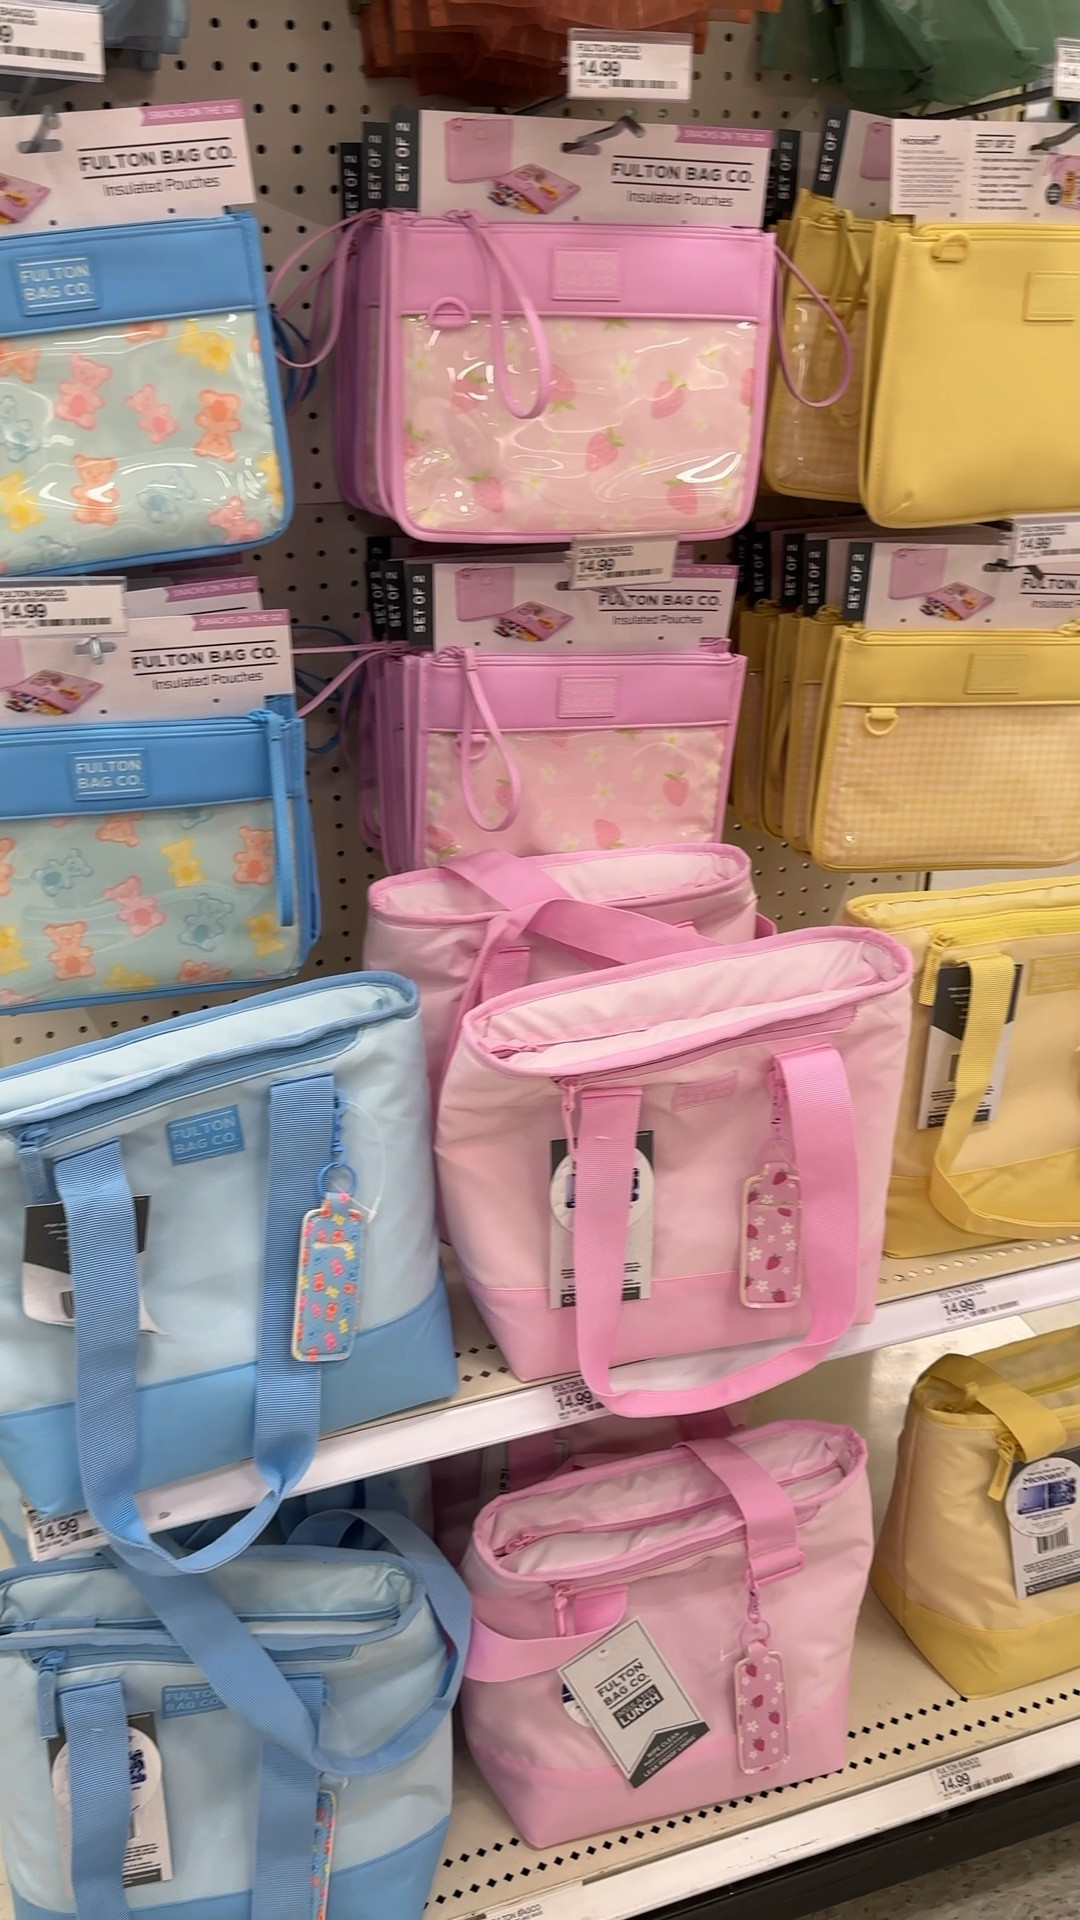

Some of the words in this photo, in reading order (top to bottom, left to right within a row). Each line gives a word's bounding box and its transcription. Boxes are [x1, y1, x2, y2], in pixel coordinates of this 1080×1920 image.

[578, 59, 621, 77] 14.99
[395, 122, 411, 132] 2
[395, 137, 411, 158] OF
[824, 132, 838, 151] OF
[78, 151, 157, 172] FULTON
[160, 149, 201, 165] BAG
[204, 146, 238, 161] CO.
[367, 148, 382, 168] OF
[778, 154, 792, 172] OF
[344, 168, 358, 187] OF
[395, 163, 410, 192] SET
[611, 162, 681, 180] FULTON
[684, 166, 722, 182] BAG
[725, 169, 755, 184] CO.
[818, 155, 835, 182] SET
[103, 179, 163, 197] Insulated
[165, 176, 221, 191] Pouches
[367, 172, 382, 200] SET
[777, 175, 791, 200] SET
[627, 190, 681, 206] Insulated
[683, 193, 734, 207] Pouches
[20, 264, 91, 284] FULTON
[23, 285, 62, 301] BAG
[1020, 537, 1052, 550] 14.99
[579, 558, 615, 573] 14.99
[753, 554, 764, 569] OF
[786, 555, 797, 571] OF
[852, 553, 865, 562] 2
[412, 575, 426, 583] 2
[808, 562, 821, 578] OF
[850, 565, 864, 582] OF
[371, 583, 384, 599] OF
[753, 572, 765, 593] SET
[784, 574, 797, 597] SET
[1020, 578, 1077, 590] FULTON
[386, 584, 399, 600] OF
[412, 588, 426, 605] OF
[662, 595, 694, 606] BAG
[697, 595, 722, 607] CO.
[807, 582, 820, 604] SET
[847, 586, 861, 609] SET
[1, 603, 48, 619] 14.99
[373, 603, 387, 624] SET
[388, 604, 402, 627] SET
[612, 615, 658, 625] Insulated
[660, 614, 704, 625] Pouches
[413, 608, 427, 633] SET
[131, 652, 204, 670] FULTON
[209, 649, 246, 663] BAG
[250, 647, 280, 659] CO.
[152, 675, 210, 690] Insulated
[211, 672, 264, 686] Pouches
[75, 760, 142, 775] FULTON
[77, 776, 113, 789] BAG
[171, 1116, 236, 1141] FULTON
[174, 1138, 208, 1154] BAG
[943, 1298, 976, 1316] 14.99
[556, 1390, 593, 1411] 14.99
[34, 1518, 79, 1543] 14.99
[597, 1661, 644, 1697] FULTON
[165, 1690, 215, 1702] FULTO
[603, 1685, 629, 1706] BAG
[630, 1673, 650, 1688] CO.
[166, 1701, 196, 1711] BAG
[619, 1693, 661, 1726] LUNCH
[940, 1772, 970, 1792] 14.99
